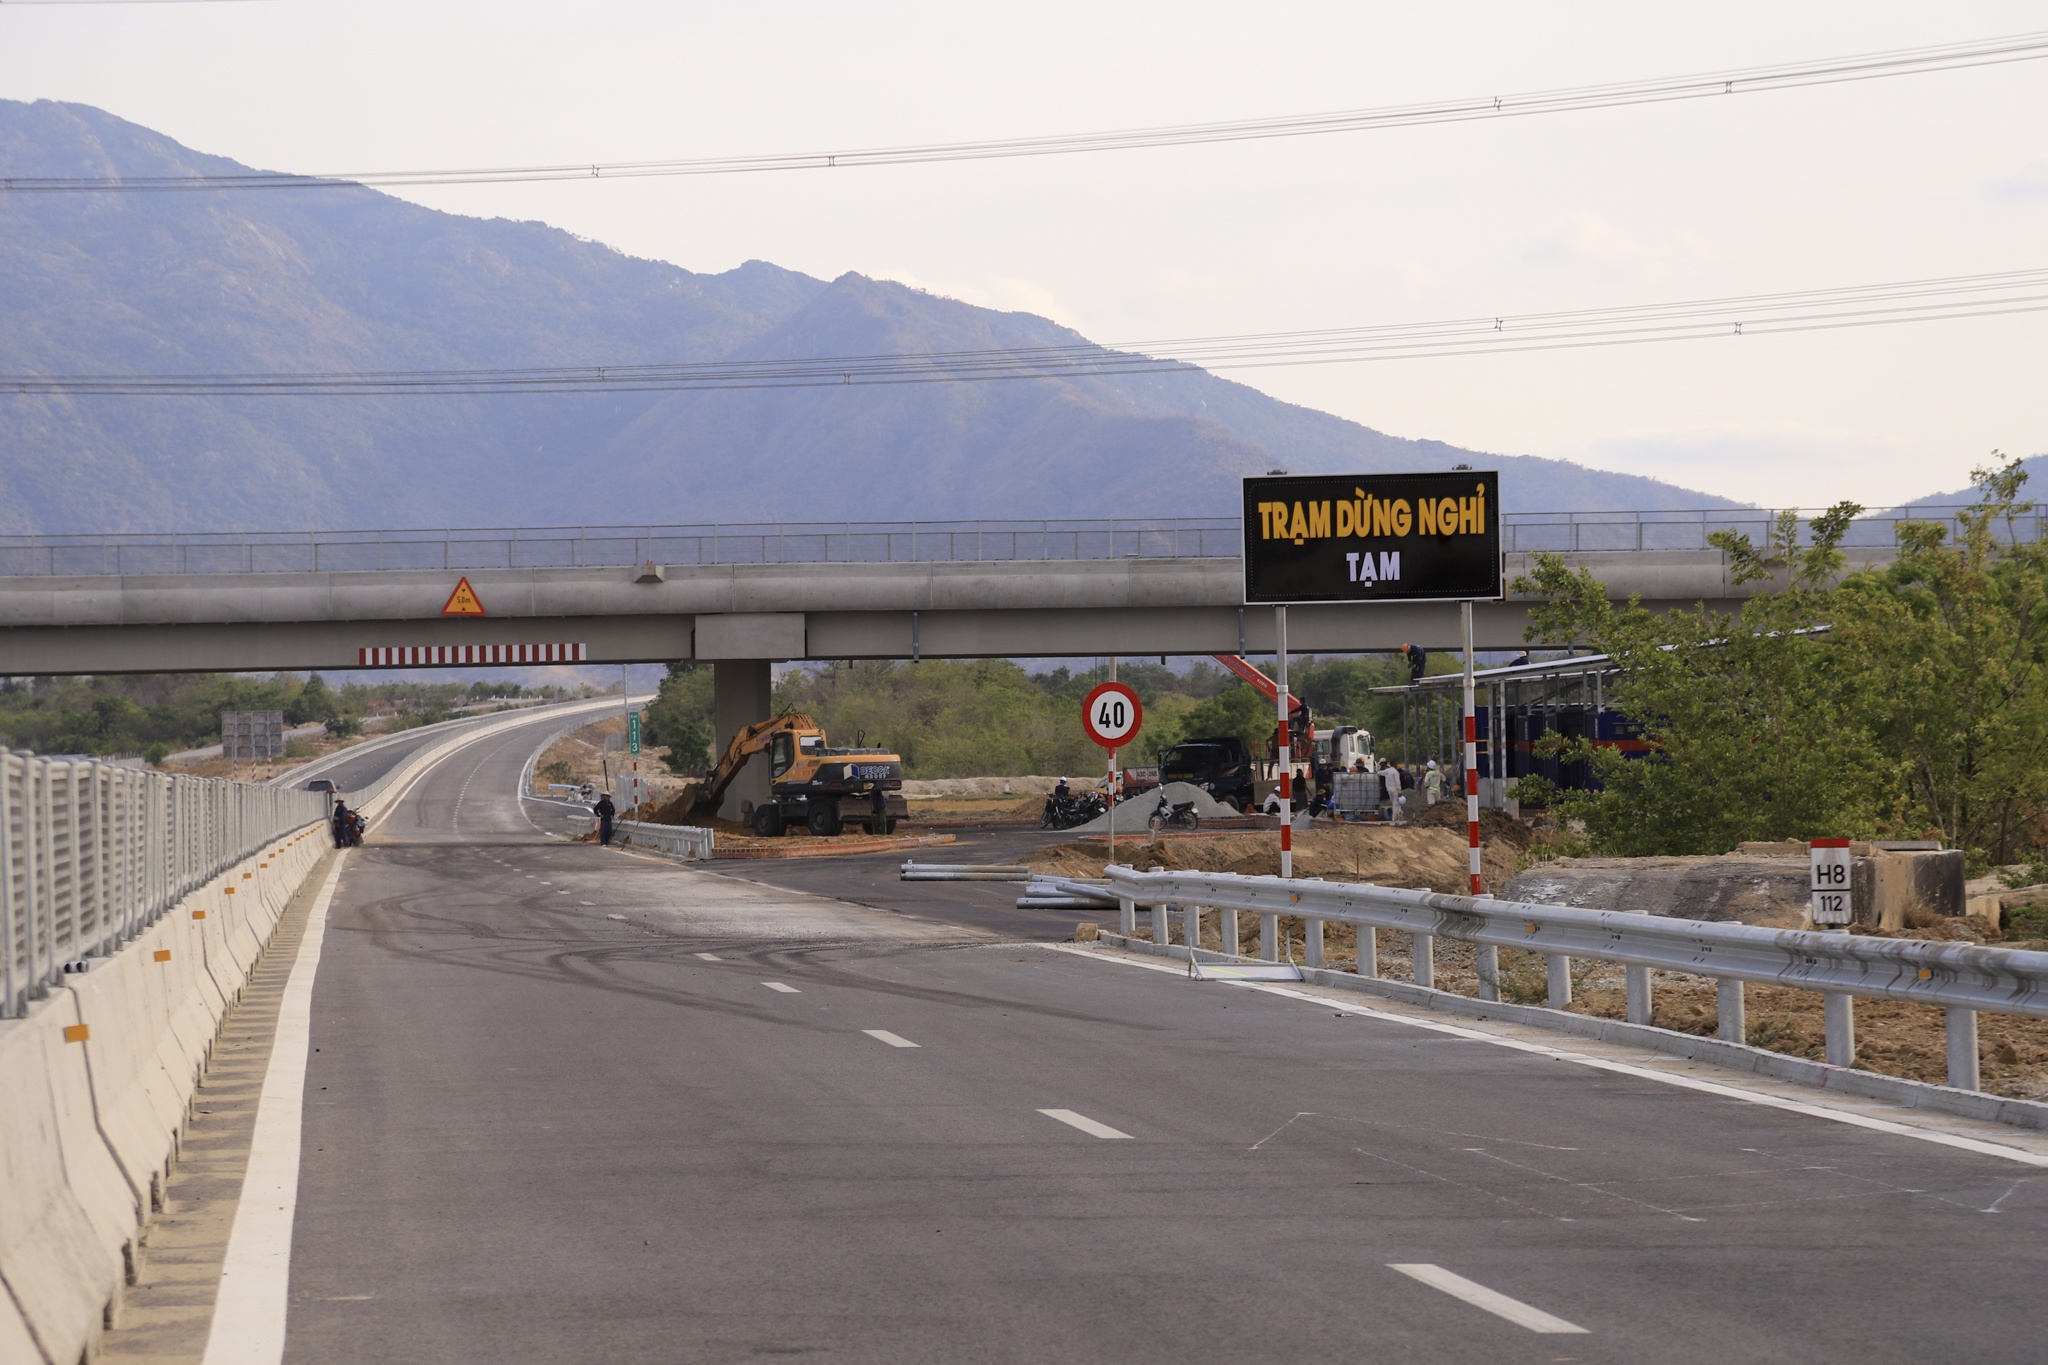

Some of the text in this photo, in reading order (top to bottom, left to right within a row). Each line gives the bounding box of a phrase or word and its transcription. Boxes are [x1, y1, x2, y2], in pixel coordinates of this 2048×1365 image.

[1258, 482, 1486, 546] TRẠM DỪNG NGHỈ
[1346, 551, 1401, 587] TẠM
[1098, 701, 1125, 729] 40
[1816, 864, 1846, 885] H8
[1820, 895, 1843, 912] 112
